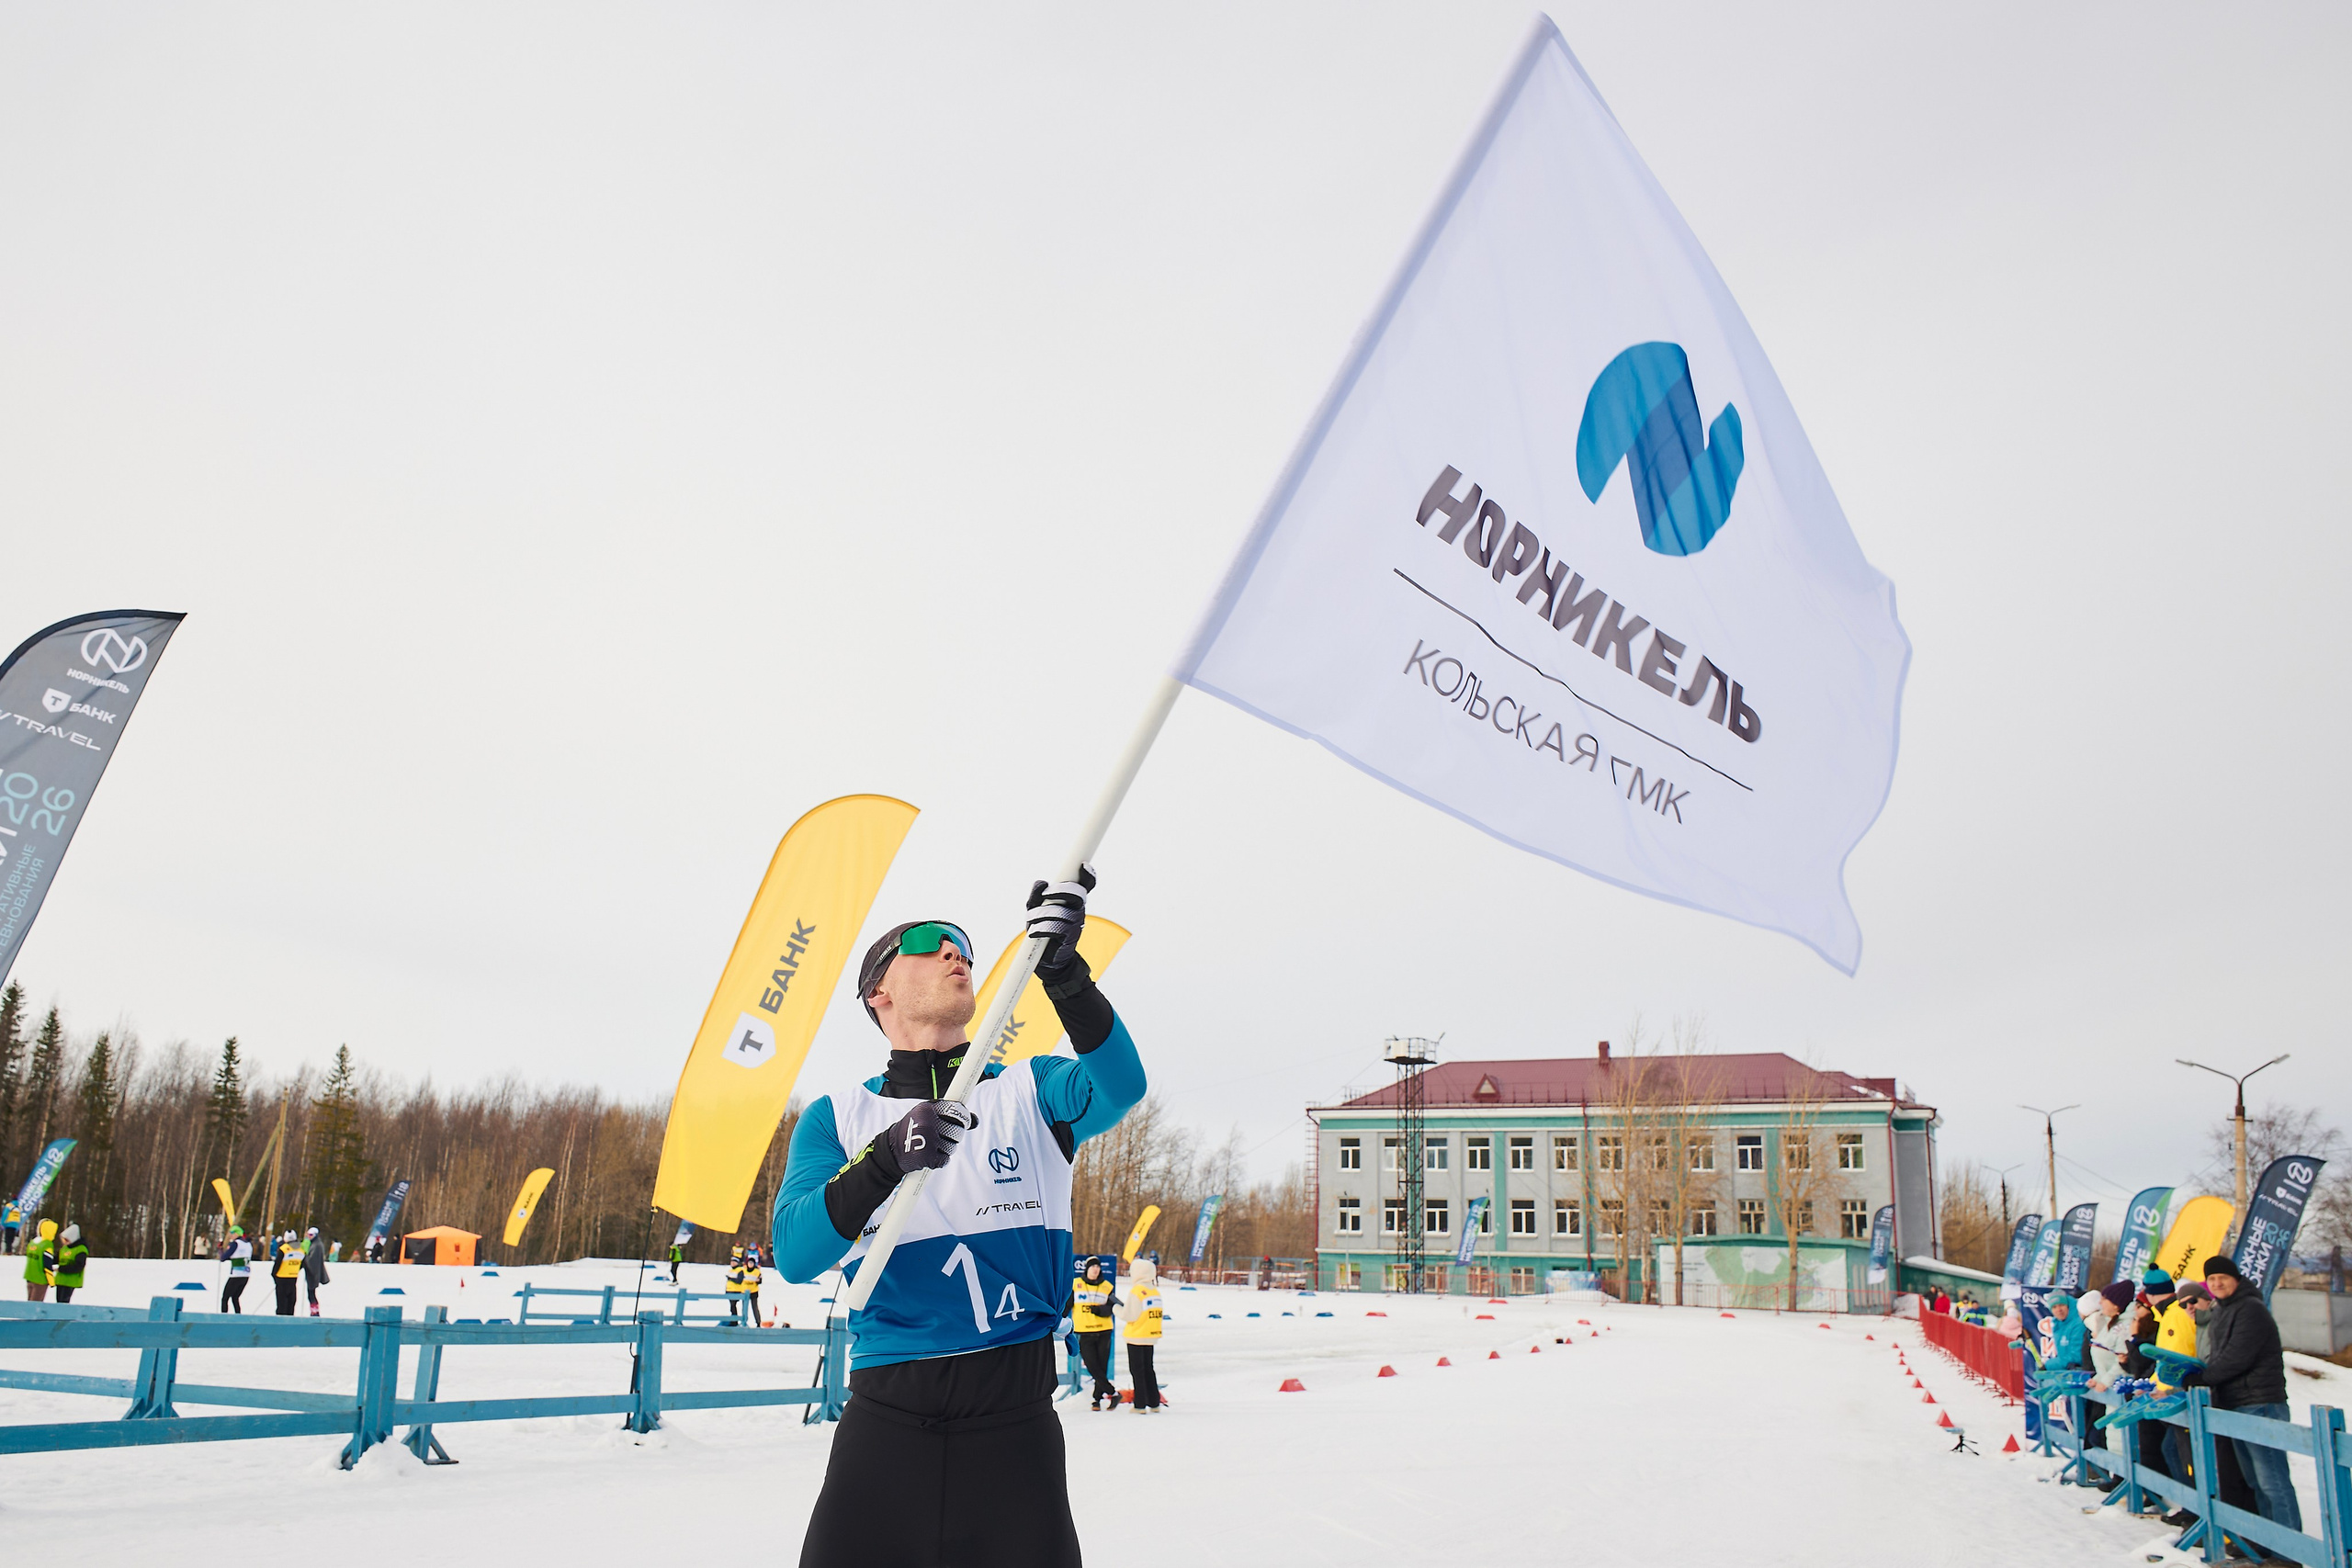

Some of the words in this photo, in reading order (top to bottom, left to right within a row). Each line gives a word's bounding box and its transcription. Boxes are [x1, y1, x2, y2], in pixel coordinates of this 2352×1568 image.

[1416, 464, 1761, 743] НОРНИКЕЛЬ
[66, 668, 130, 694] НОРНИКЕЛЬ
[13, 714, 101, 751] TRAVEL
[69, 703, 117, 724] БАНК
[1403, 639, 1599, 773] КОЛЬСКАЯ
[1610, 755, 1690, 825] ГМК
[30, 786, 75, 836] 26
[0, 858, 45, 955] ЕВНОВАНИЯ
[759, 917, 817, 1014] БАНК
[863, 1224, 882, 1237] БАН
[2240, 1216, 2267, 1278] ЫЖНЫЕ
[2172, 1244, 2197, 1280] БАНК
[2249, 1241, 2274, 1289] ОНКИ
